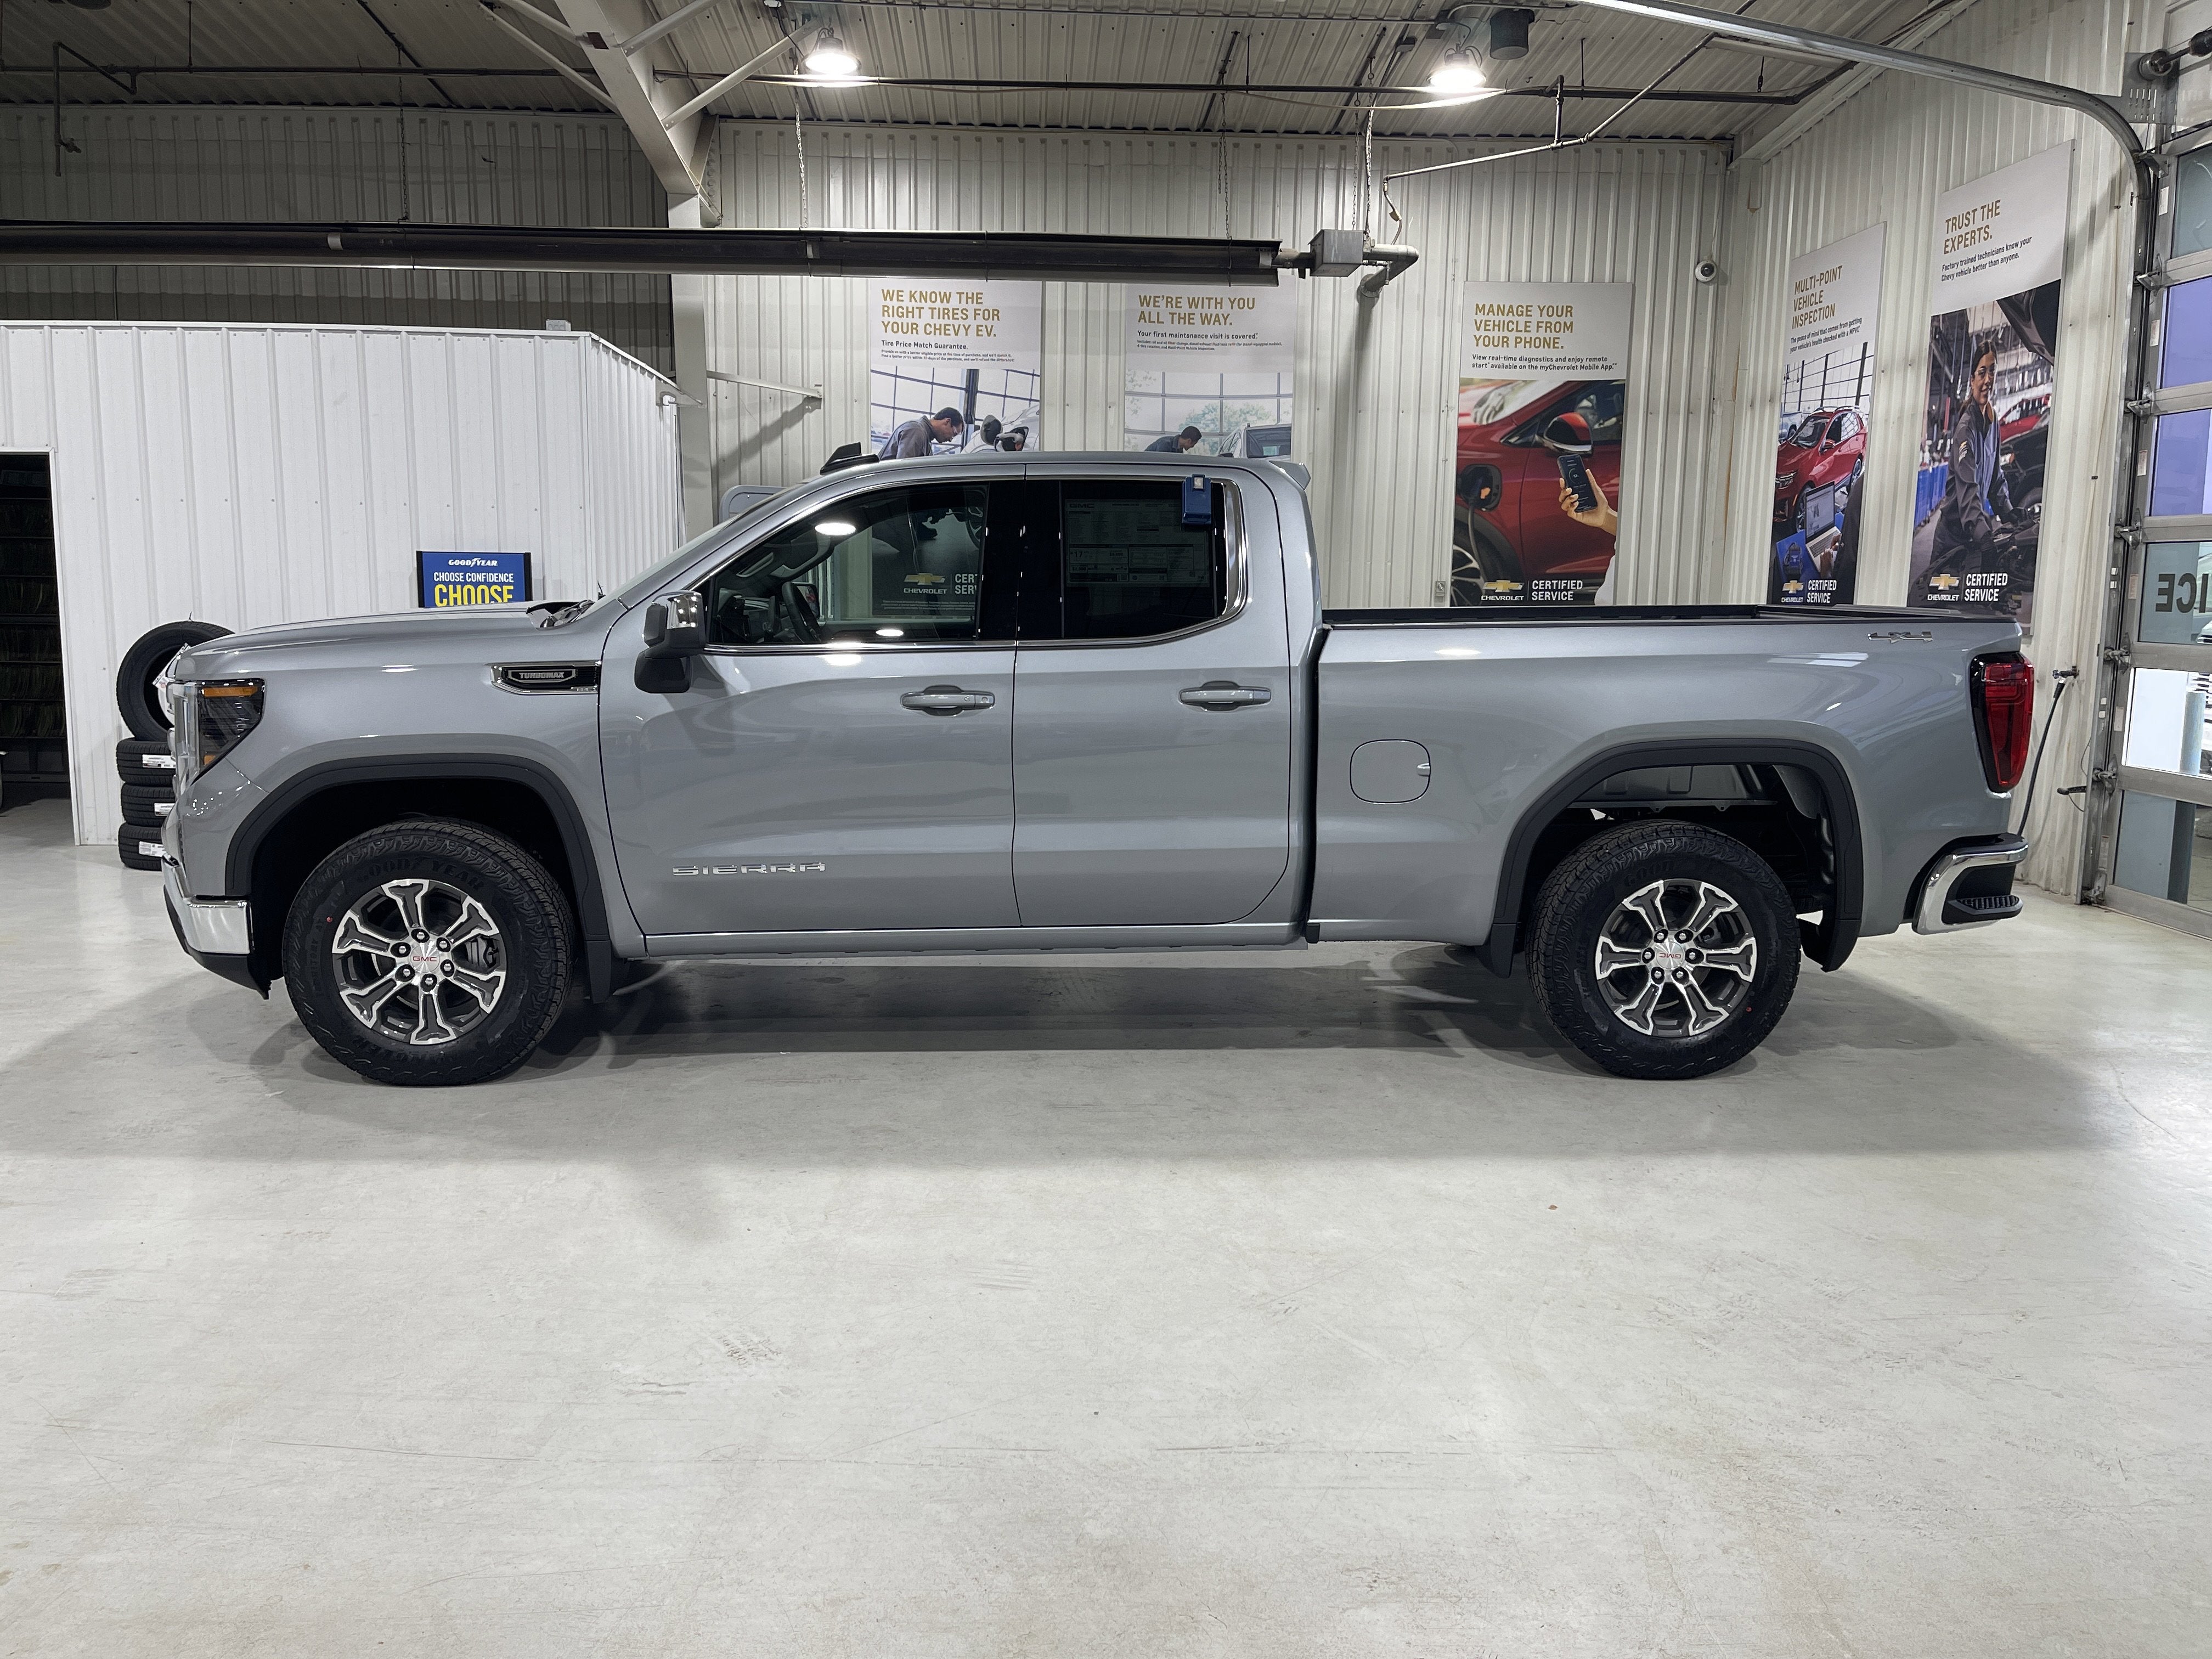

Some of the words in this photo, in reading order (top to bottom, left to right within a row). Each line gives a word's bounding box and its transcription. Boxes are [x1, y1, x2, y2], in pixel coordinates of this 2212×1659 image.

[1945, 208, 1977, 234] TRUST
[1980, 200, 2001, 222] THE
[1944, 224, 1993, 255] EXPERTS.
[1942, 261, 1959, 272] Factory
[1960, 254, 1976, 266] trained
[1977, 246, 2005, 261] technicians
[2006, 241, 2019, 251] know
[2020, 237, 2032, 248] your
[1942, 273, 1955, 281] Chevy
[1956, 267, 1972, 278] vehicle
[1973, 263, 1988, 272] better
[1988, 259, 1999, 268] than
[2000, 252, 2019, 264] anyone.
[1795, 266, 1842, 295] MULTI-POINT
[882, 289, 904, 302] WE
[909, 290, 952, 304] KNOW
[956, 292, 983, 304] THE
[1138, 295, 1182, 308] WE'RE
[1187, 297, 1223, 309] WITH
[1228, 297, 1255, 309] YOU
[1793, 290, 1824, 312] VEHICLE
[882, 305, 924, 319] RIGHT
[928, 307, 968, 320] TIRES
[974, 308, 1000, 321] FOR
[1475, 303, 1533, 317] MANAGE
[1537, 305, 1573, 317] YOUR
[1792, 303, 1836, 329] INSPECTION
[1138, 311, 1164, 324] ALL
[1169, 312, 1195, 325] THE
[1199, 313, 1232, 326] WAY.
[882, 321, 919, 335] YOUR
[924, 324, 971, 337] CHEVY
[976, 324, 997, 337] EV.
[1474, 319, 1531, 332] VEHICLE
[1536, 321, 1573, 333] FROM
[1474, 335, 1509, 348] YOUR
[1514, 336, 1564, 349] PHONE.
[448, 557, 498, 567] GOODYEAR
[433, 572, 464, 582] CHOOSE
[466, 573, 514, 583] CONFIDENCE
[955, 574, 978, 583] CER
[1966, 573, 2008, 586] CERTIFIED
[1532, 580, 1583, 590] CERTIFIED
[1808, 580, 1837, 590] CERTIFIED
[435, 584, 514, 607] CHOOSE
[1532, 591, 1573, 601] SERVICE
[1807, 592, 1831, 603] SERVICE
[1964, 589, 1999, 601] SERVICE
[673, 862, 825, 876] SIERRA
